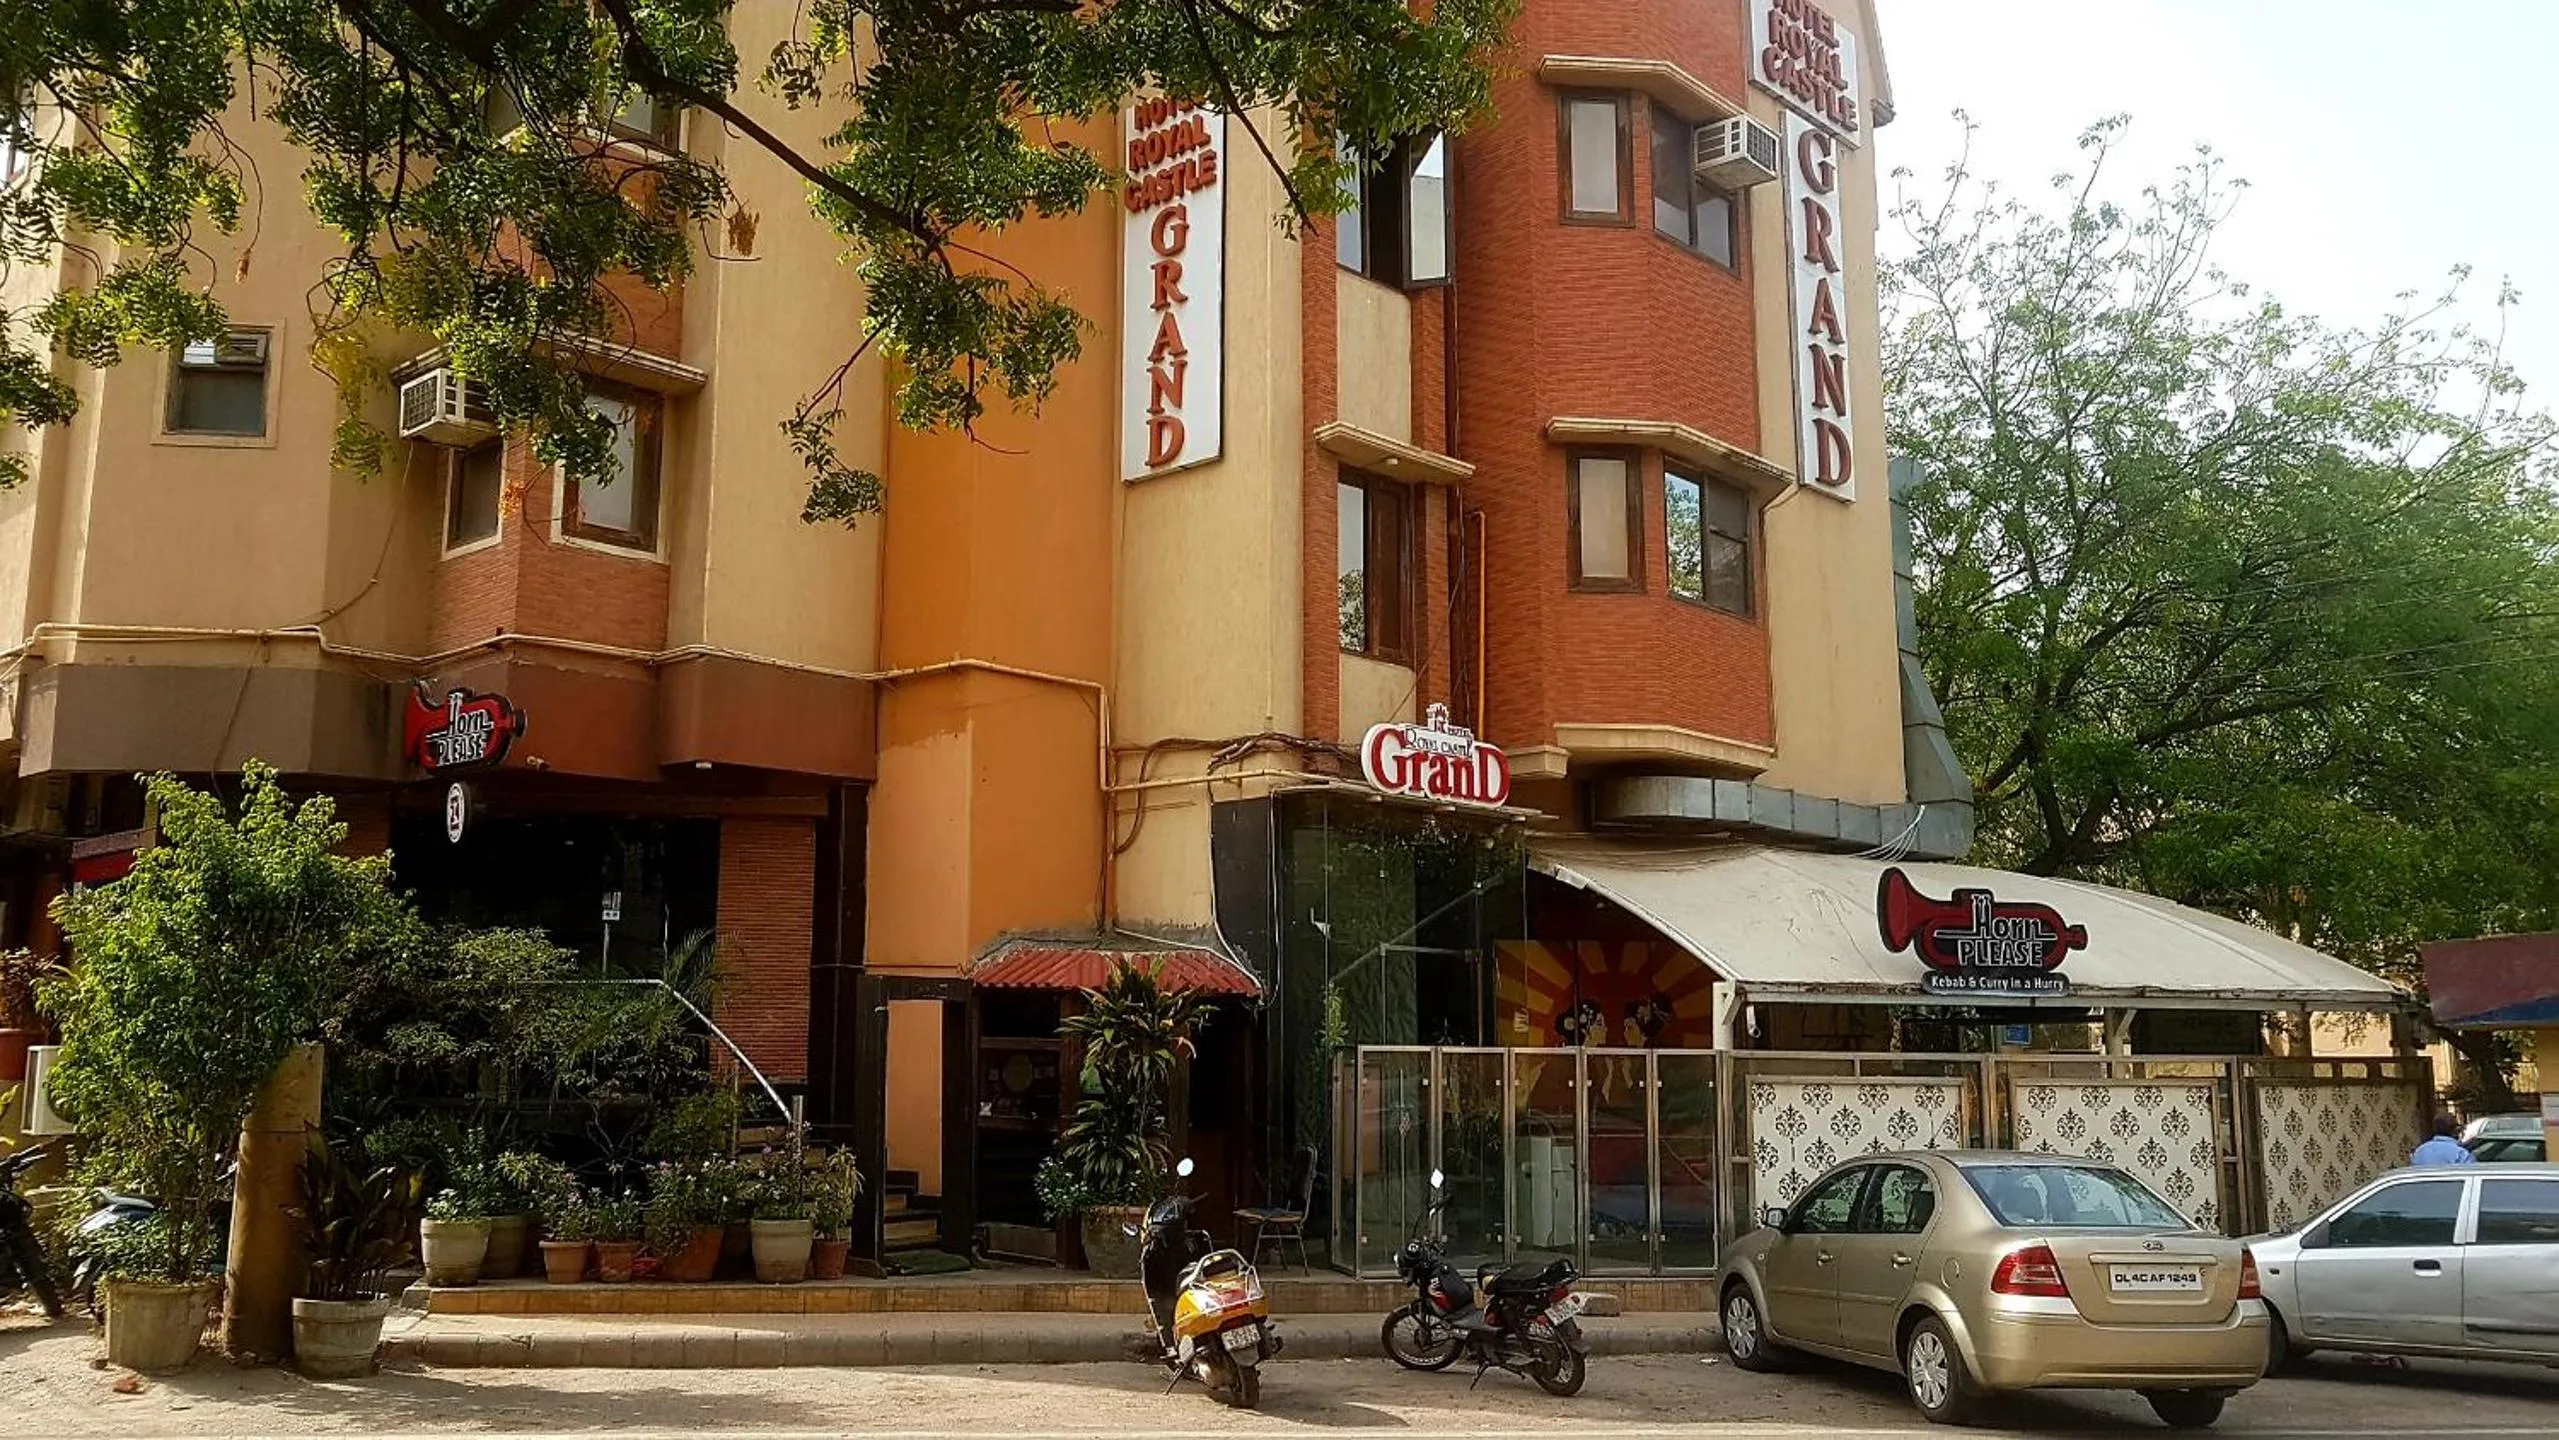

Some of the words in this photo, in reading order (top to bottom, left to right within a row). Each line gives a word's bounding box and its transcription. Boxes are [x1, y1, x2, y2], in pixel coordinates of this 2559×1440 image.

[1768, 9, 1848, 92] ROYAL
[1762, 46, 1858, 131] CASTLE
[1129, 114, 1211, 173] ROYAL
[1124, 149, 1217, 213] CASTLE
[1144, 203, 1189, 468] GRAND
[1798, 129, 1852, 487] GRAND
[437, 733, 486, 767] PLEASE
[1971, 894, 2050, 940] Horn
[1957, 939, 2042, 967] PLEASE
[1932, 976, 1966, 988] Kebab
[1968, 976, 1976, 988] &
[1980, 977, 2008, 990] Curry
[2024, 979, 2031, 988] a
[2034, 978, 2063, 992] Hurry
